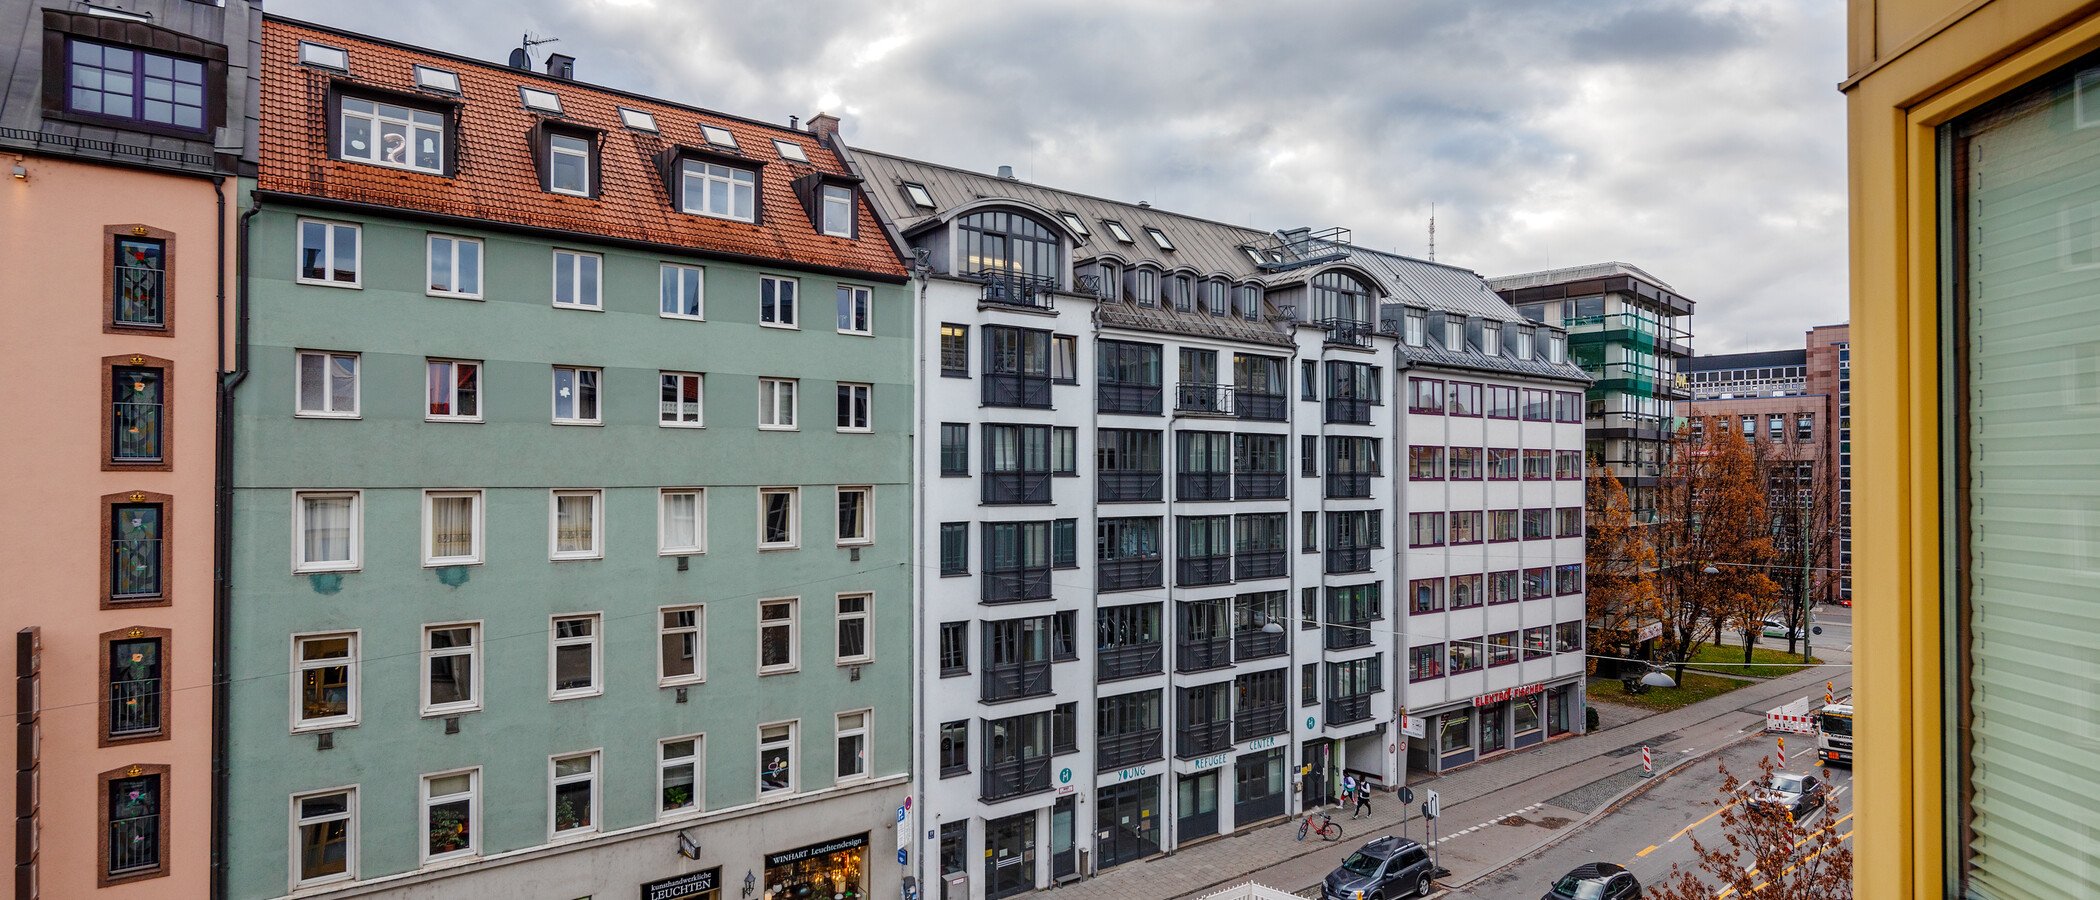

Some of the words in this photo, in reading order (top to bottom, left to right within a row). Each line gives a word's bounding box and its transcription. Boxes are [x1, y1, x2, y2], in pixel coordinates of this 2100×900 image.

[1475, 689, 1510, 707] ELEKTRO
[1514, 683, 1544, 698] FISCHER
[1117, 766, 1146, 781] YOUNG
[1195, 753, 1227, 769] REFUGEE
[1249, 737, 1275, 751] CENTER
[772, 849, 808, 864] WINHART
[811, 838, 862, 855] Leuchtendesign
[650, 879, 712, 900] LEUCHTEN
[651, 872, 712, 891] kunsthandwerkliche
